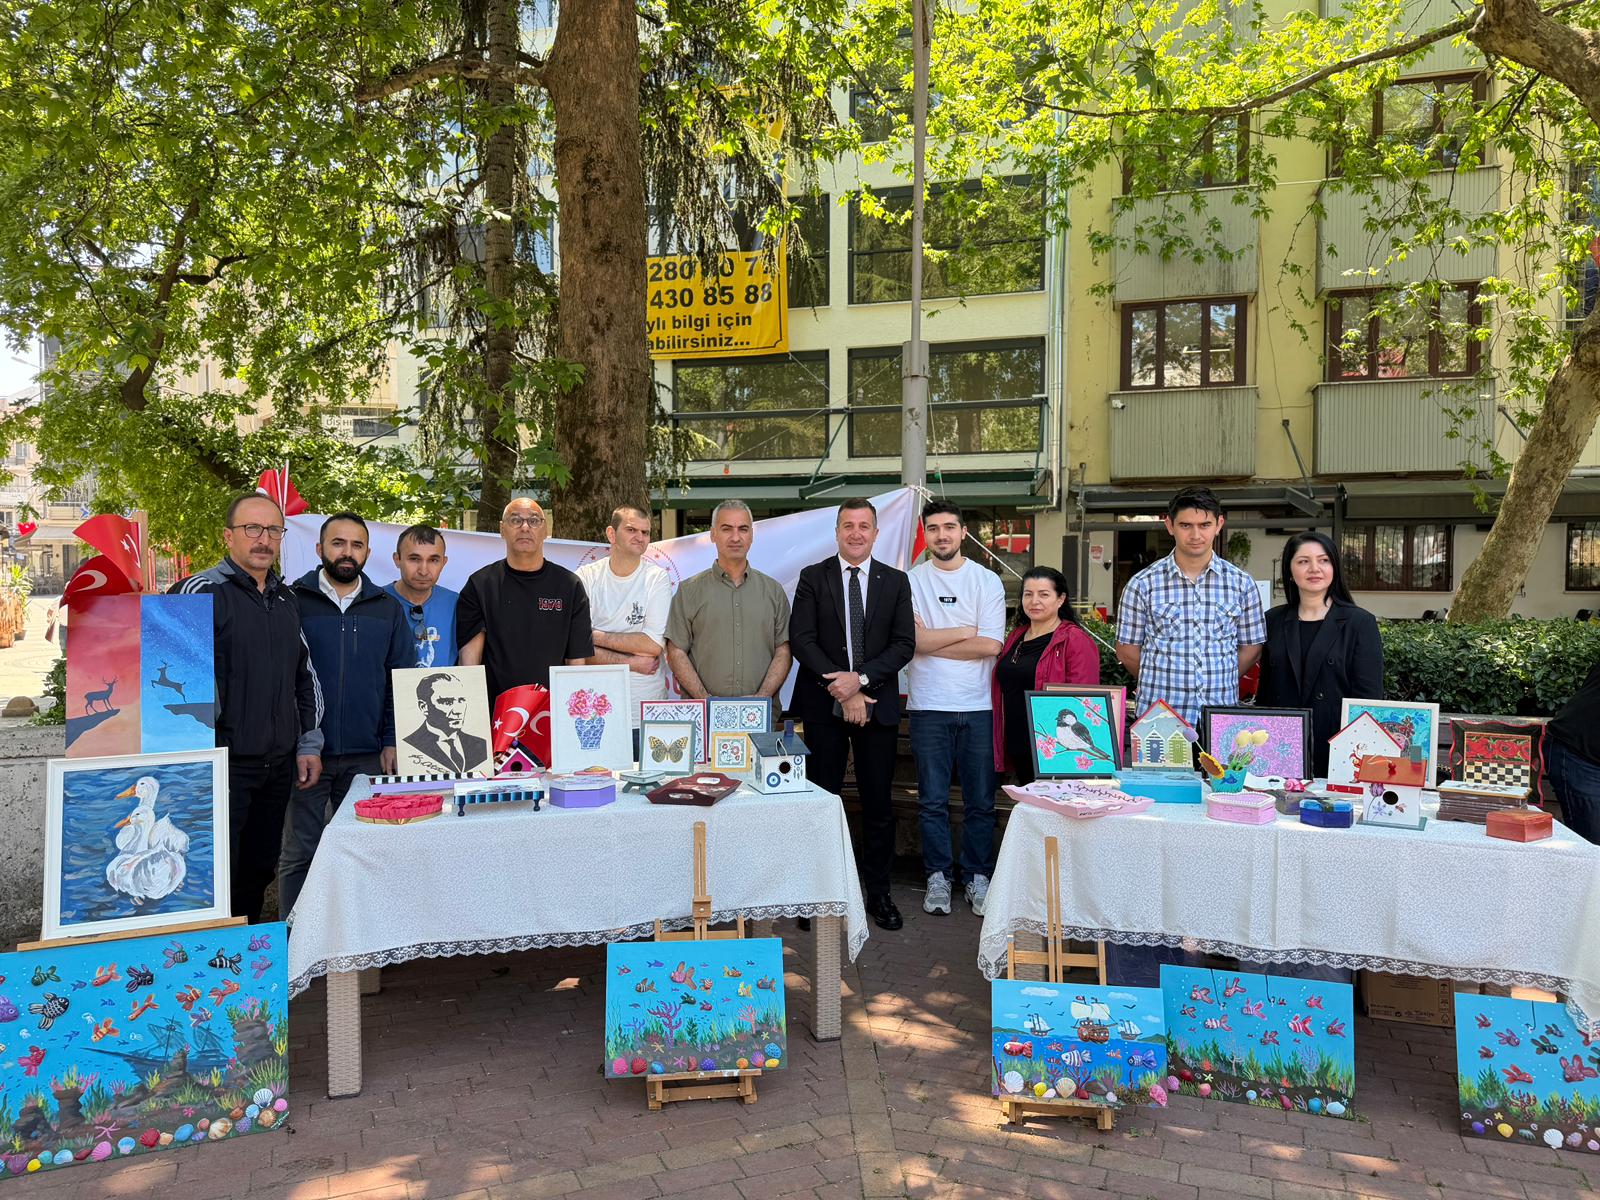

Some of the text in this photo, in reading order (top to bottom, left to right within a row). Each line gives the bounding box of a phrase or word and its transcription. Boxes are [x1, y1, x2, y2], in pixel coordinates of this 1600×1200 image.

[650, 282, 772, 309] 430 85 88
[672, 313, 710, 331] bilgi
[717, 312, 752, 330] için
